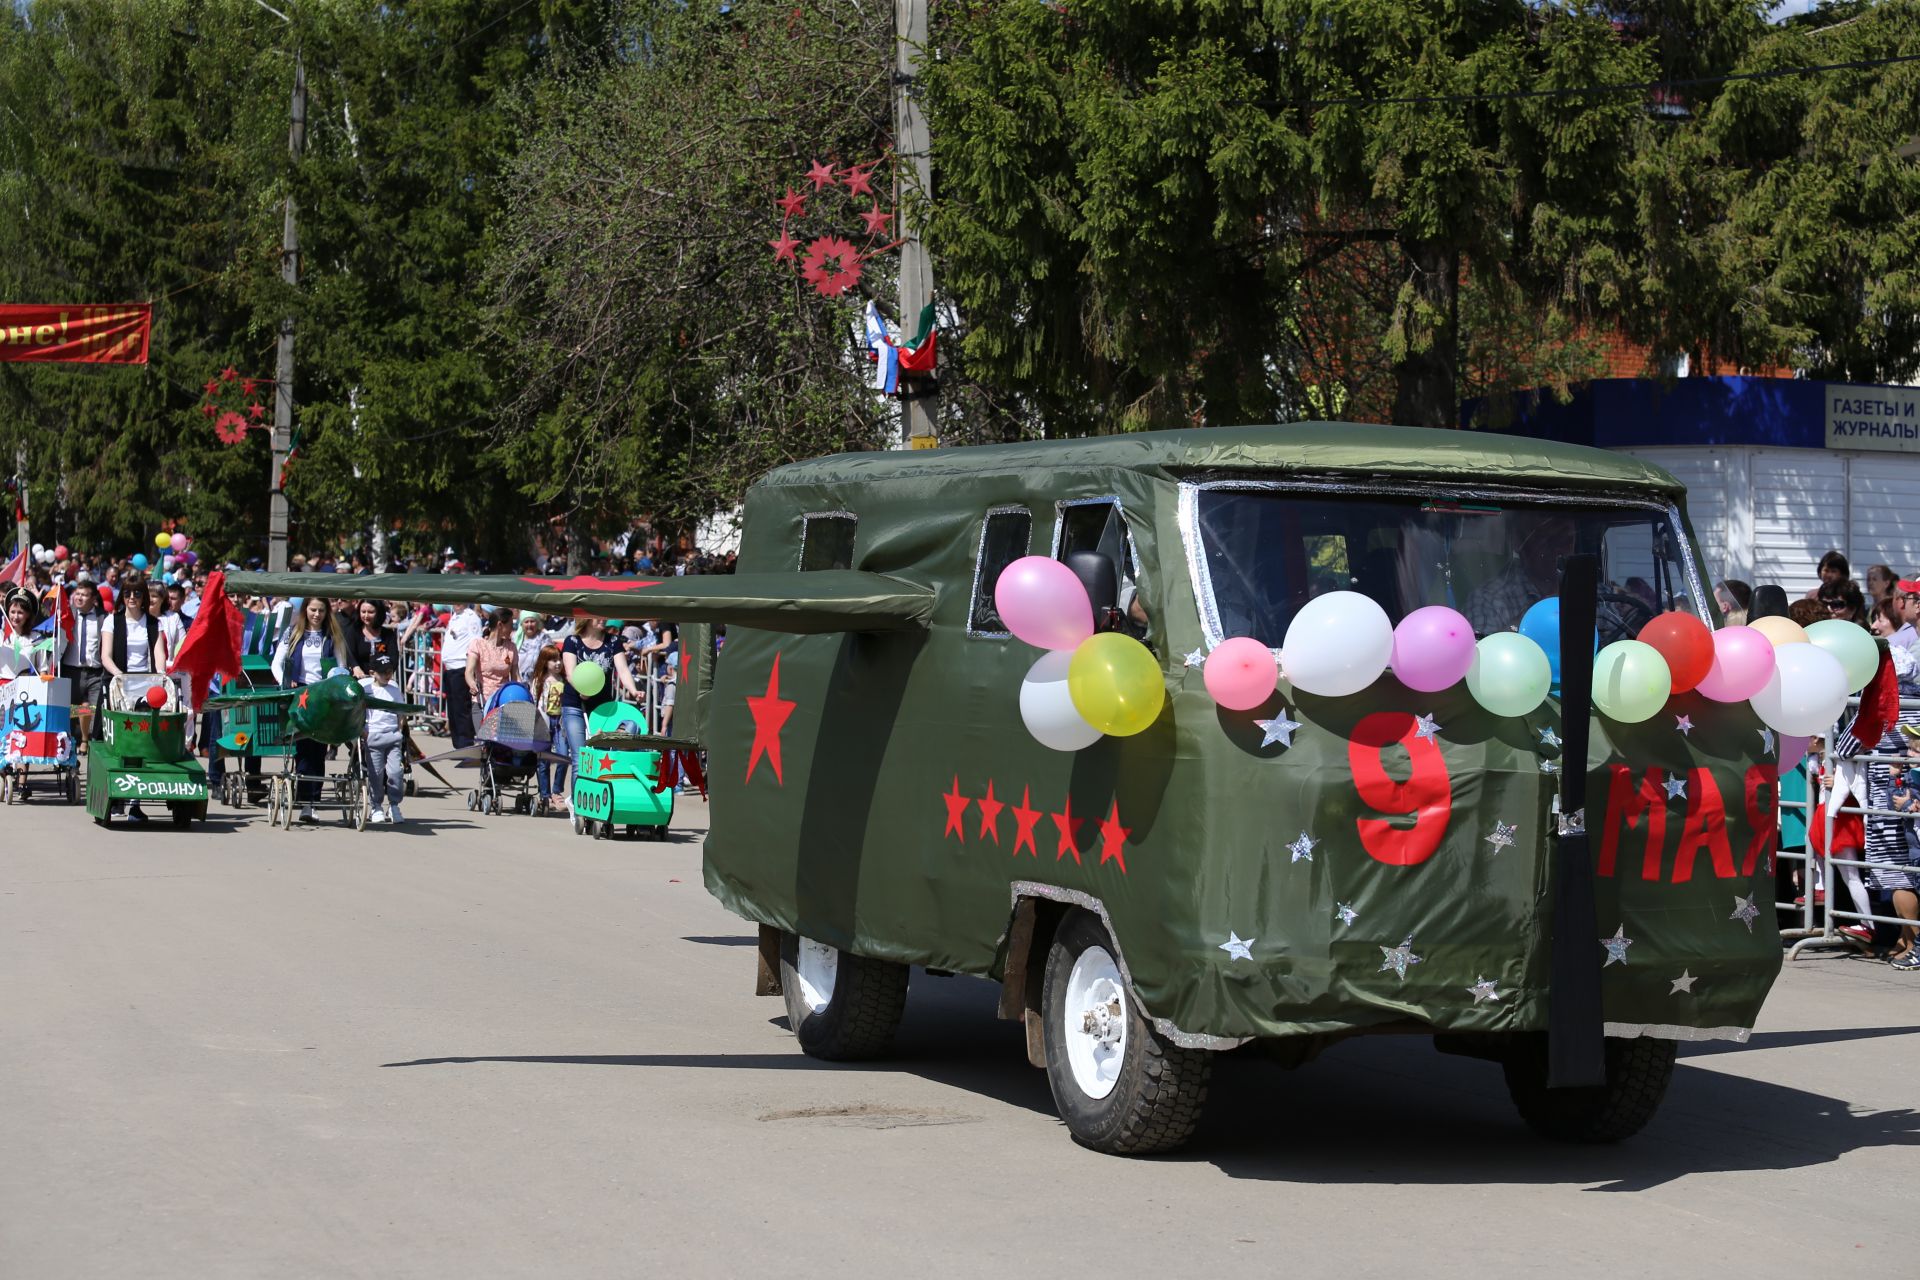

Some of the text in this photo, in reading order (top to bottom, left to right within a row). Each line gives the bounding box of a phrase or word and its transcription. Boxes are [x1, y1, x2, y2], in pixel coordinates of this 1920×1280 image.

[1833, 398, 1914, 417] ГАЗЕТЫ И
[1833, 420, 1918, 439] ЖУРНАЛЫ
[115, 773, 203, 796] ЗА РОДИНУ!
[1348, 711, 1778, 883] 9 МАЯ
